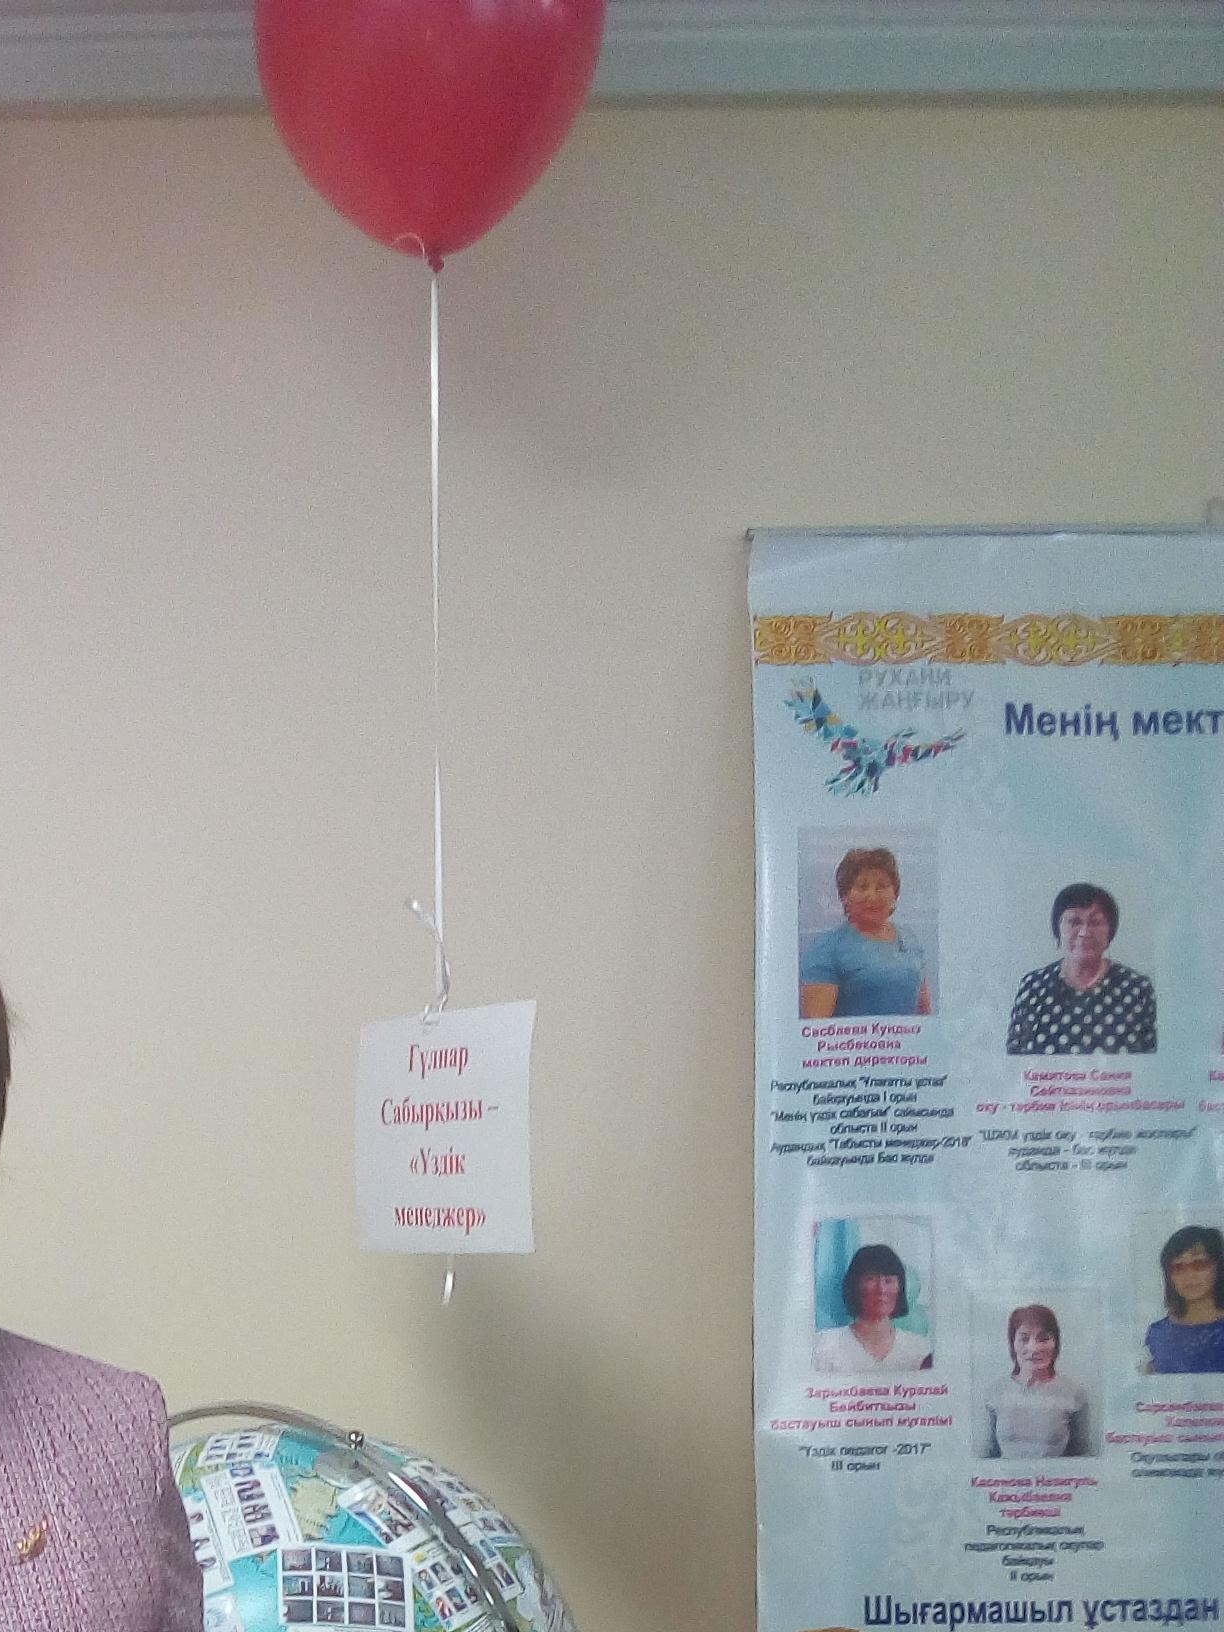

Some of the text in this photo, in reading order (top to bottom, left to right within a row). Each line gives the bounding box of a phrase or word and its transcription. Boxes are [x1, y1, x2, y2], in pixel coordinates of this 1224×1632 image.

[859, 668, 954, 687] РУХАНИ
[1004, 702, 1120, 742] Менің
[408, 1043, 469, 1079] Гүлнар
[854, 1054, 928, 1068] директоры
[380, 1096, 483, 1131] Сабырқызы
[409, 1145, 466, 1177] «Үздік
[393, 1205, 486, 1236] менеджер»
[863, 1594, 1073, 1632] Шығармашыл
